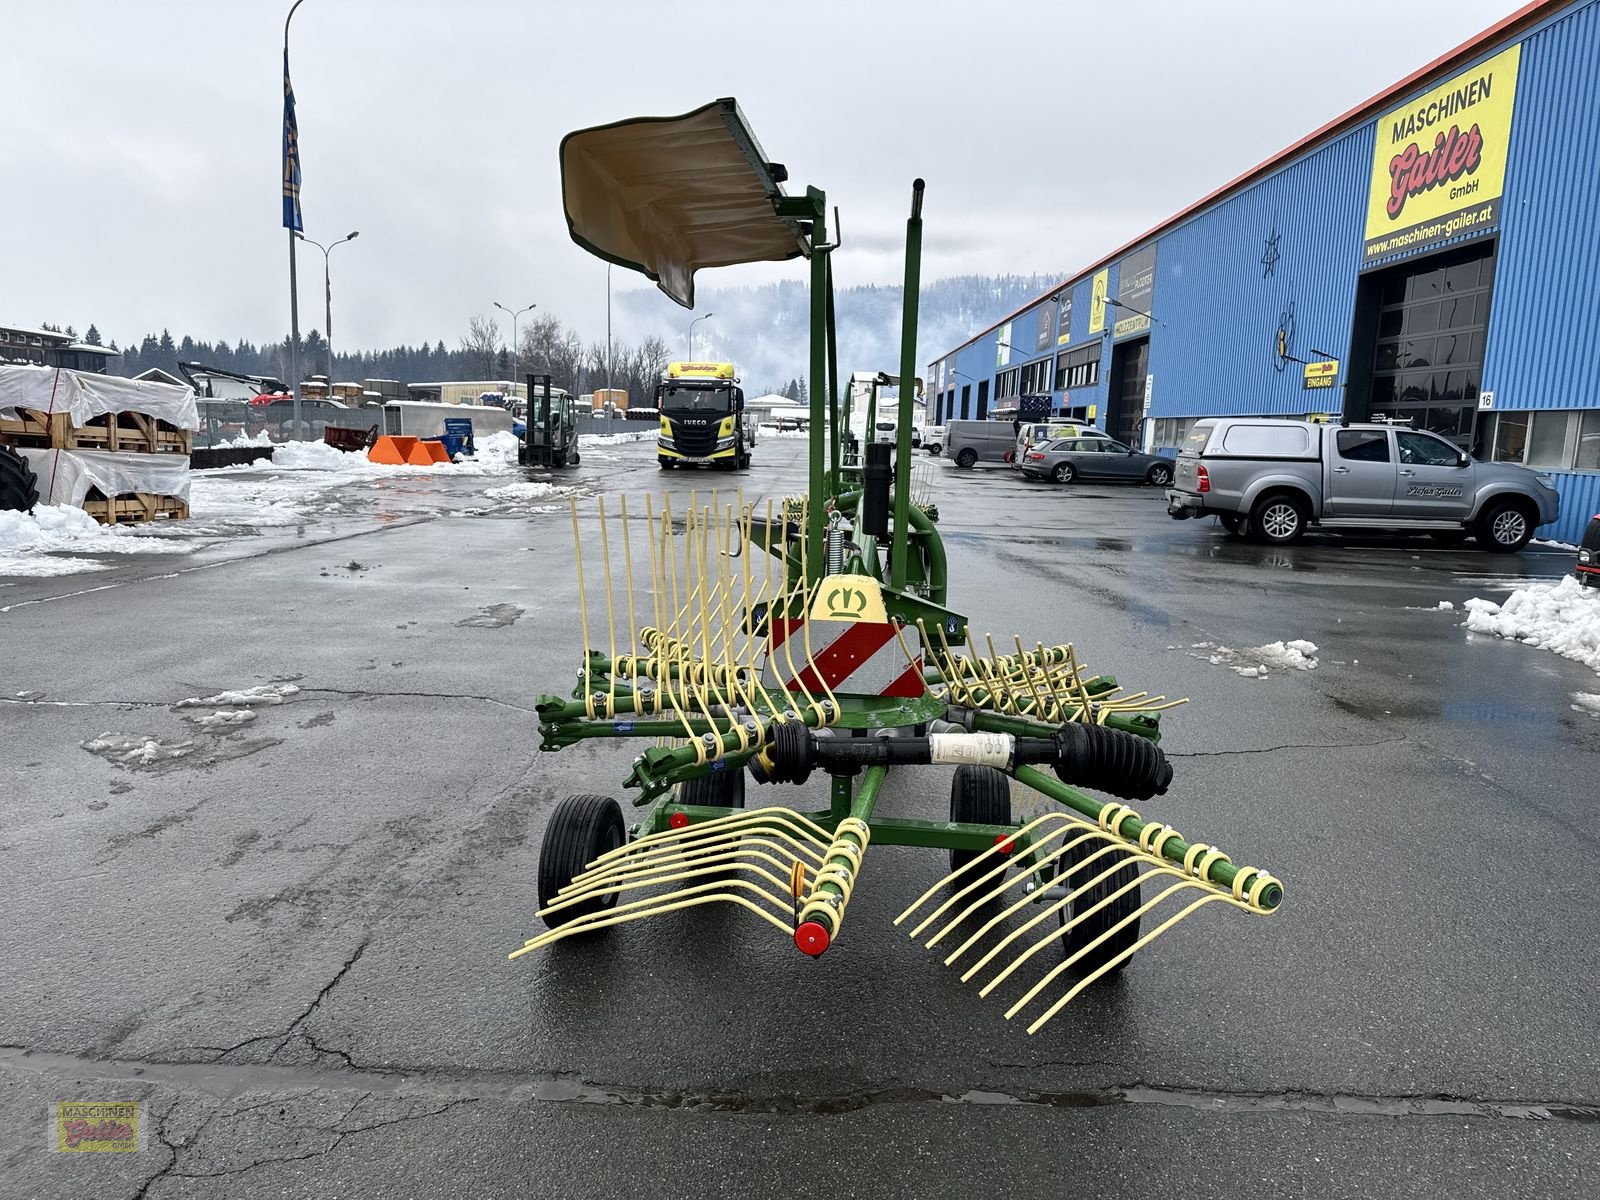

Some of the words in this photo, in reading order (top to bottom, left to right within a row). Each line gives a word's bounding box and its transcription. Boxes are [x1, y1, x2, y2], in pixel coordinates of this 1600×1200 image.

[1392, 73, 1493, 144] MASCHINEN
[1386, 123, 1484, 220] Gailer
[1449, 179, 1480, 200] GmbH
[1367, 205, 1492, 256] www.maschinen-gailer.at
[1307, 376, 1332, 388] EINGANG
[1482, 394, 1491, 406] 16
